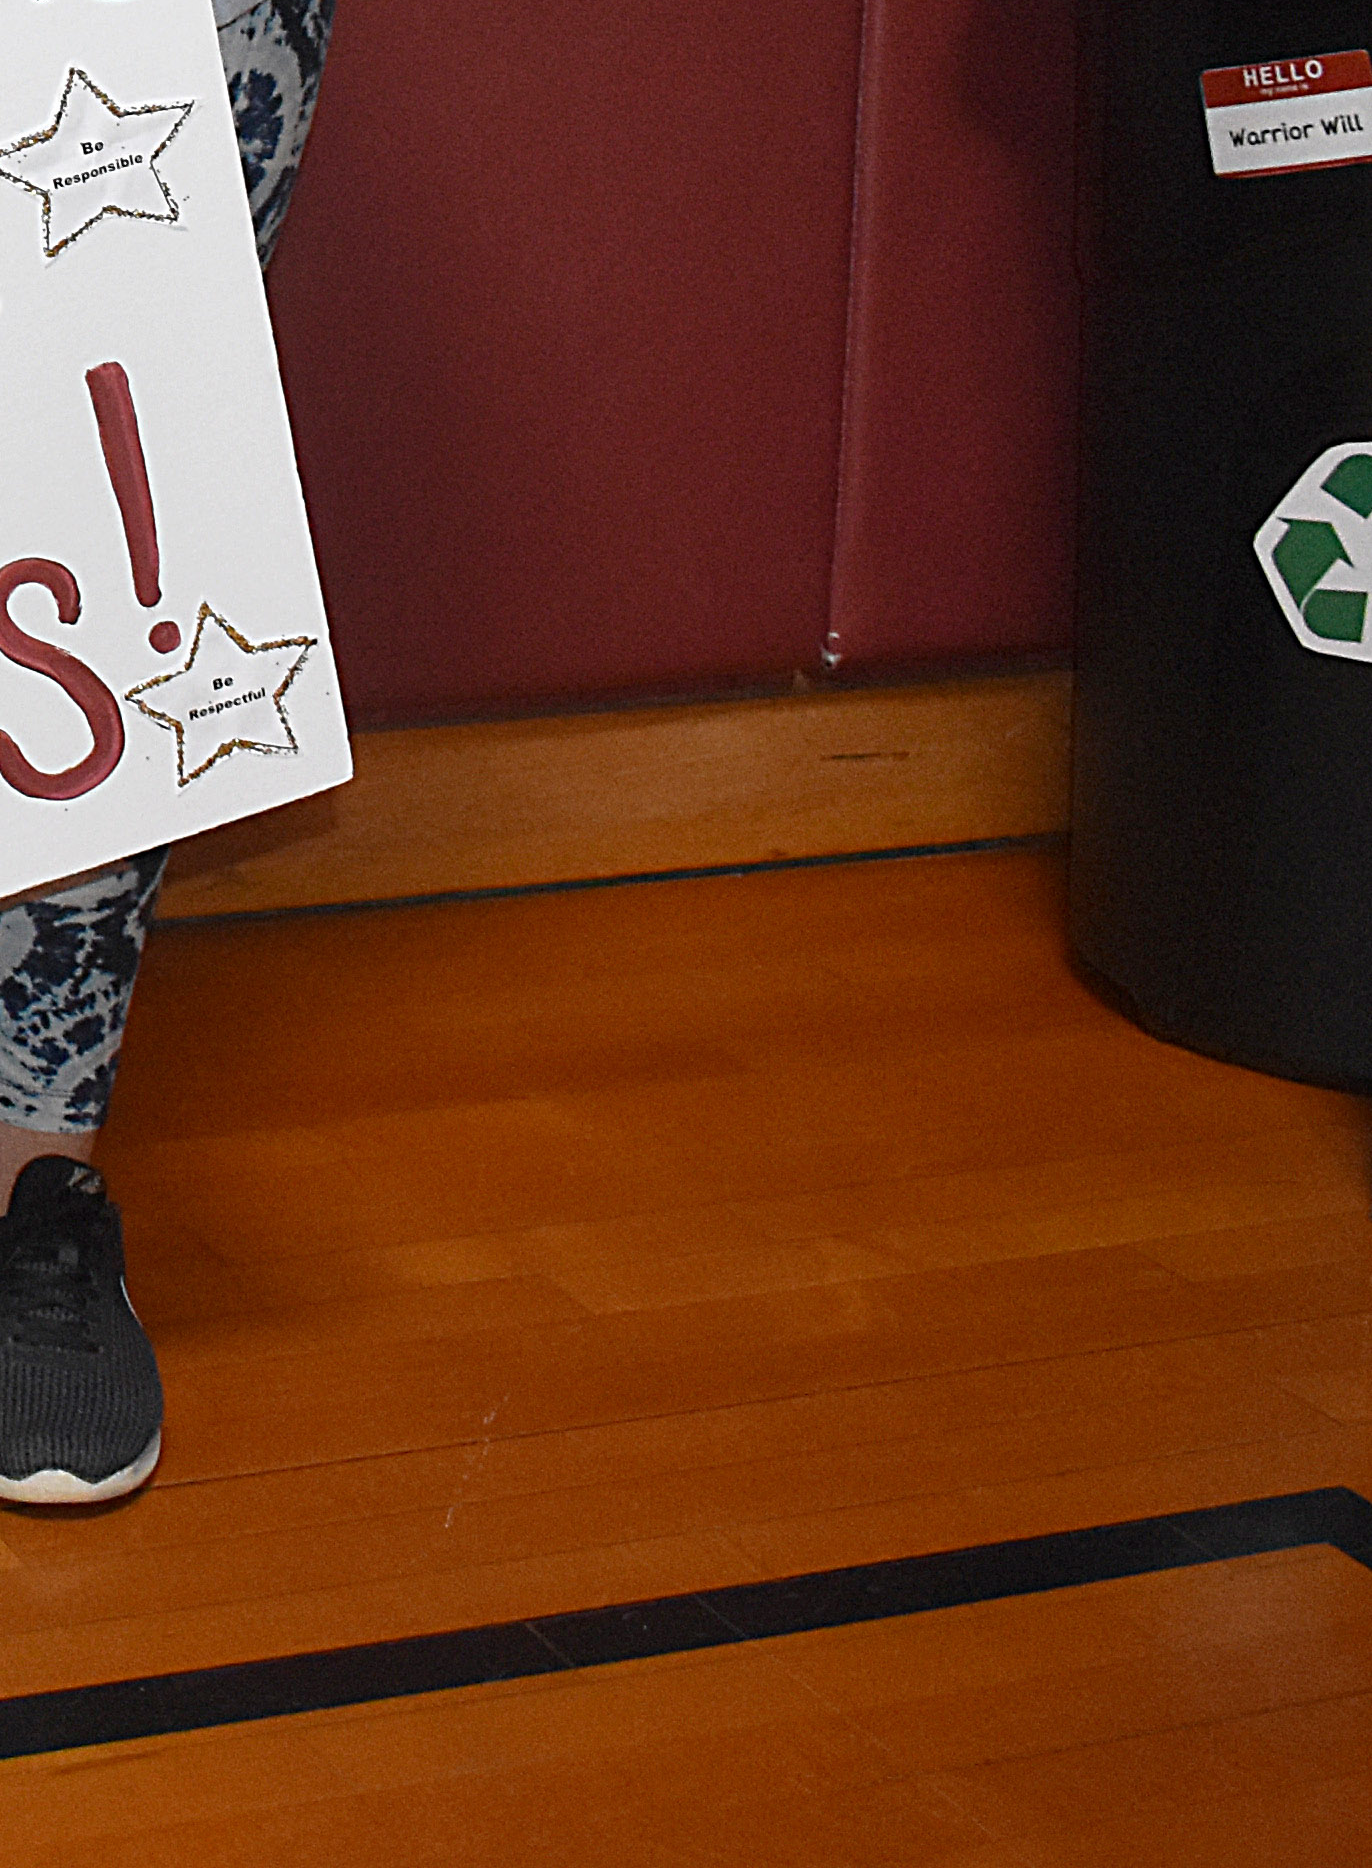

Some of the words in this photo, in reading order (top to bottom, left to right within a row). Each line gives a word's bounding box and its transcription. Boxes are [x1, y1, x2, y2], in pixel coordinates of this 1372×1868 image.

[1243, 59, 1323, 87] HELLO
[1229, 123, 1314, 147] Warrior
[1320, 114, 1364, 135] Will
[80, 141, 104, 155] Be
[53, 154, 143, 189] Responsible
[212, 677, 234, 691] Be
[189, 687, 266, 721] Respectful
